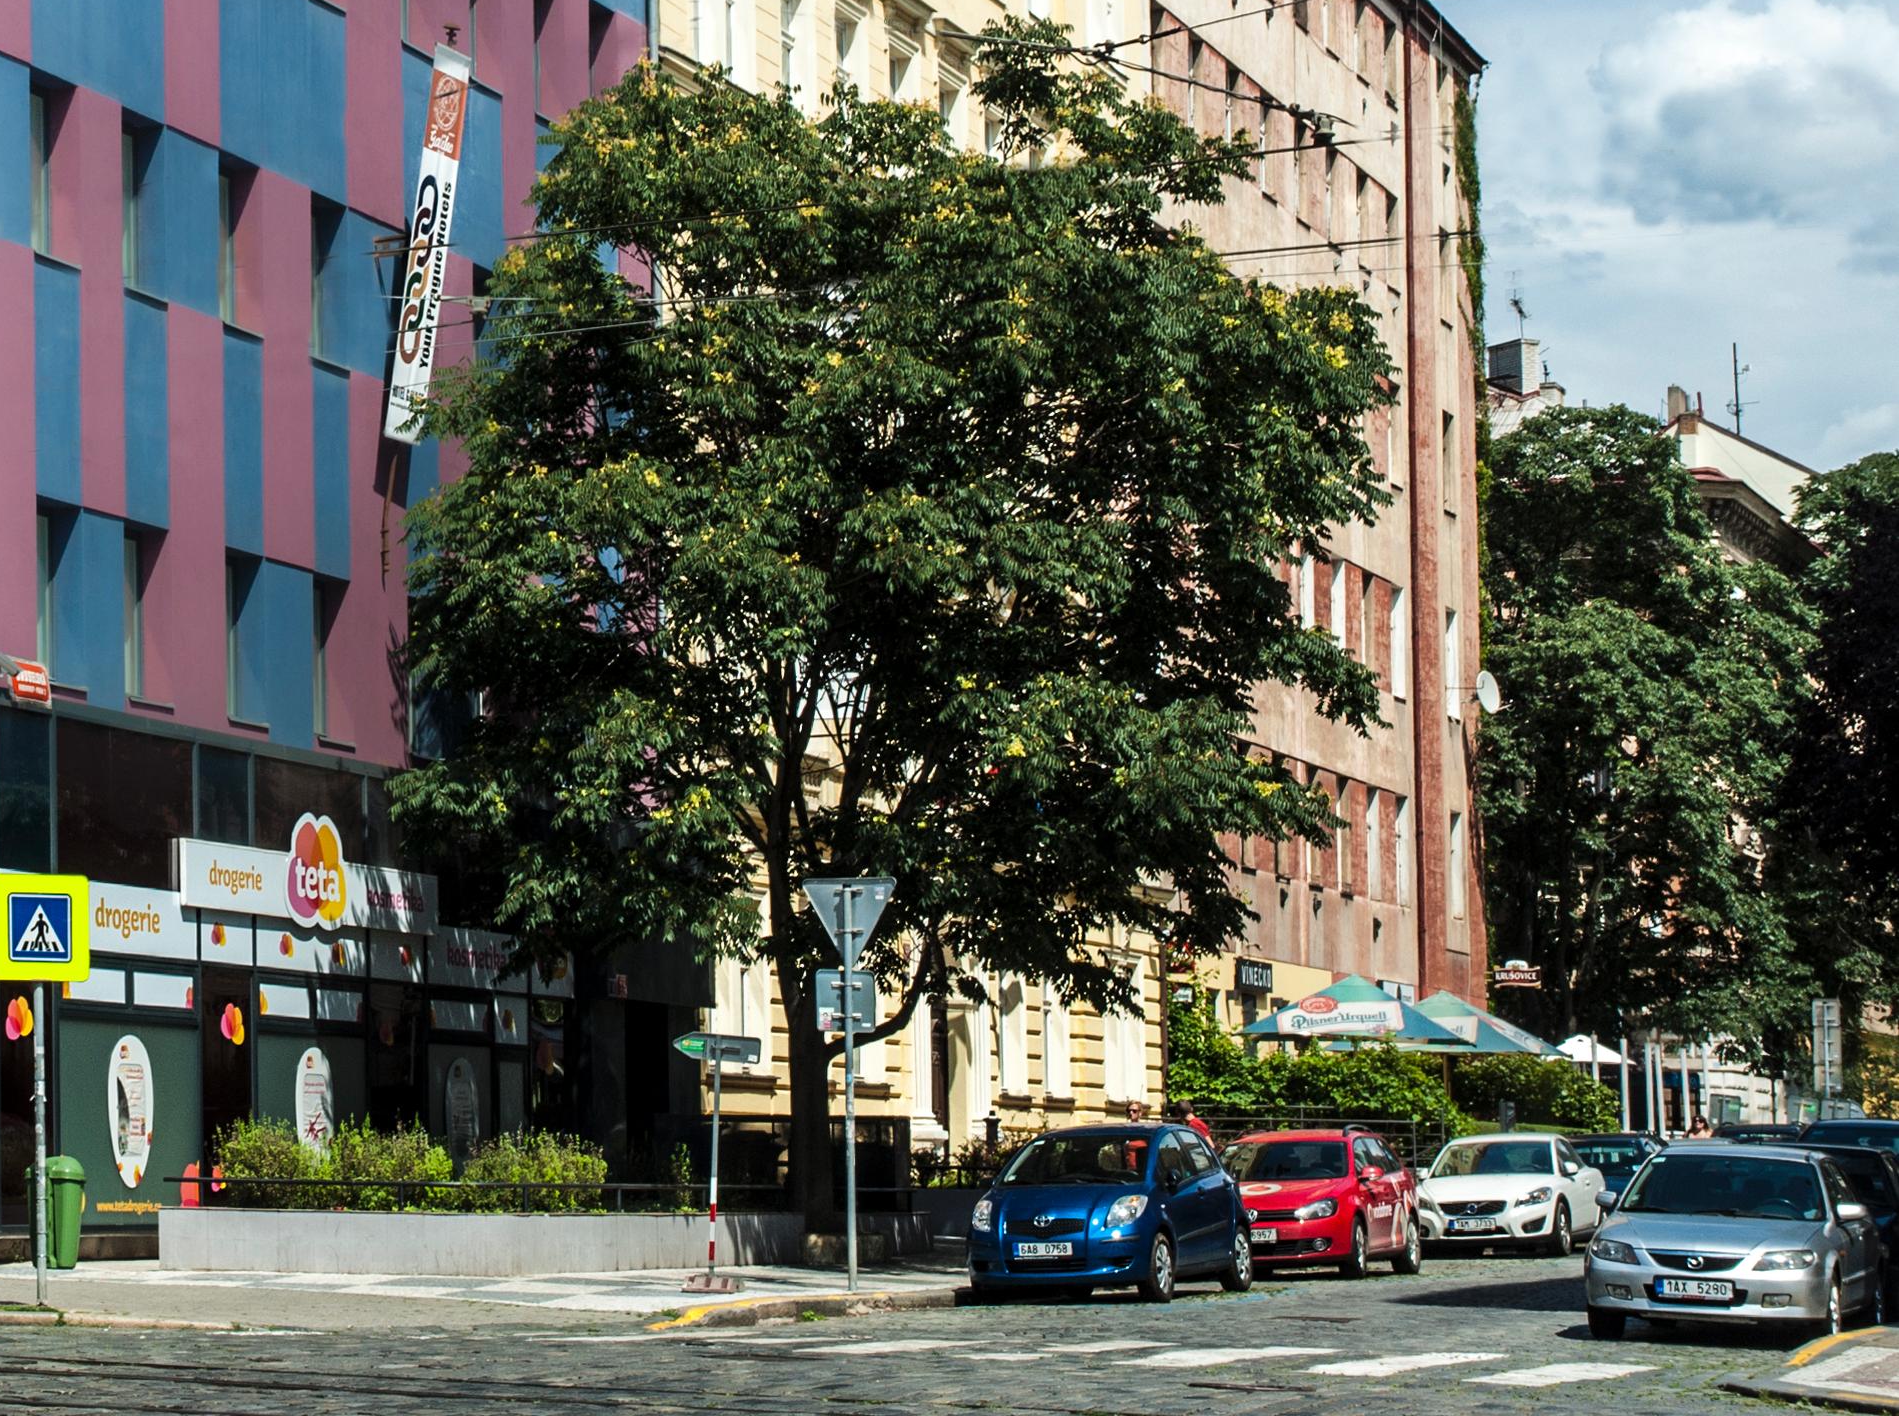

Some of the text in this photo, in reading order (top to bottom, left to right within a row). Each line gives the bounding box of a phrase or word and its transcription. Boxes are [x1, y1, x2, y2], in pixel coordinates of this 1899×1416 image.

[418, 182, 452, 369] Your Prague Hotels
[209, 857, 425, 913] drogerie teta kosmetika
[95, 897, 161, 939] drogerie
[1241, 961, 1271, 988] VÍNEČKO
[1495, 971, 1537, 981] KRUŠOVICE
[1291, 1011, 1387, 1030] Pilsner Urquell
[1020, 1244, 1038, 1254] 6A8
[1666, 1280, 1688, 1293] 1AX
